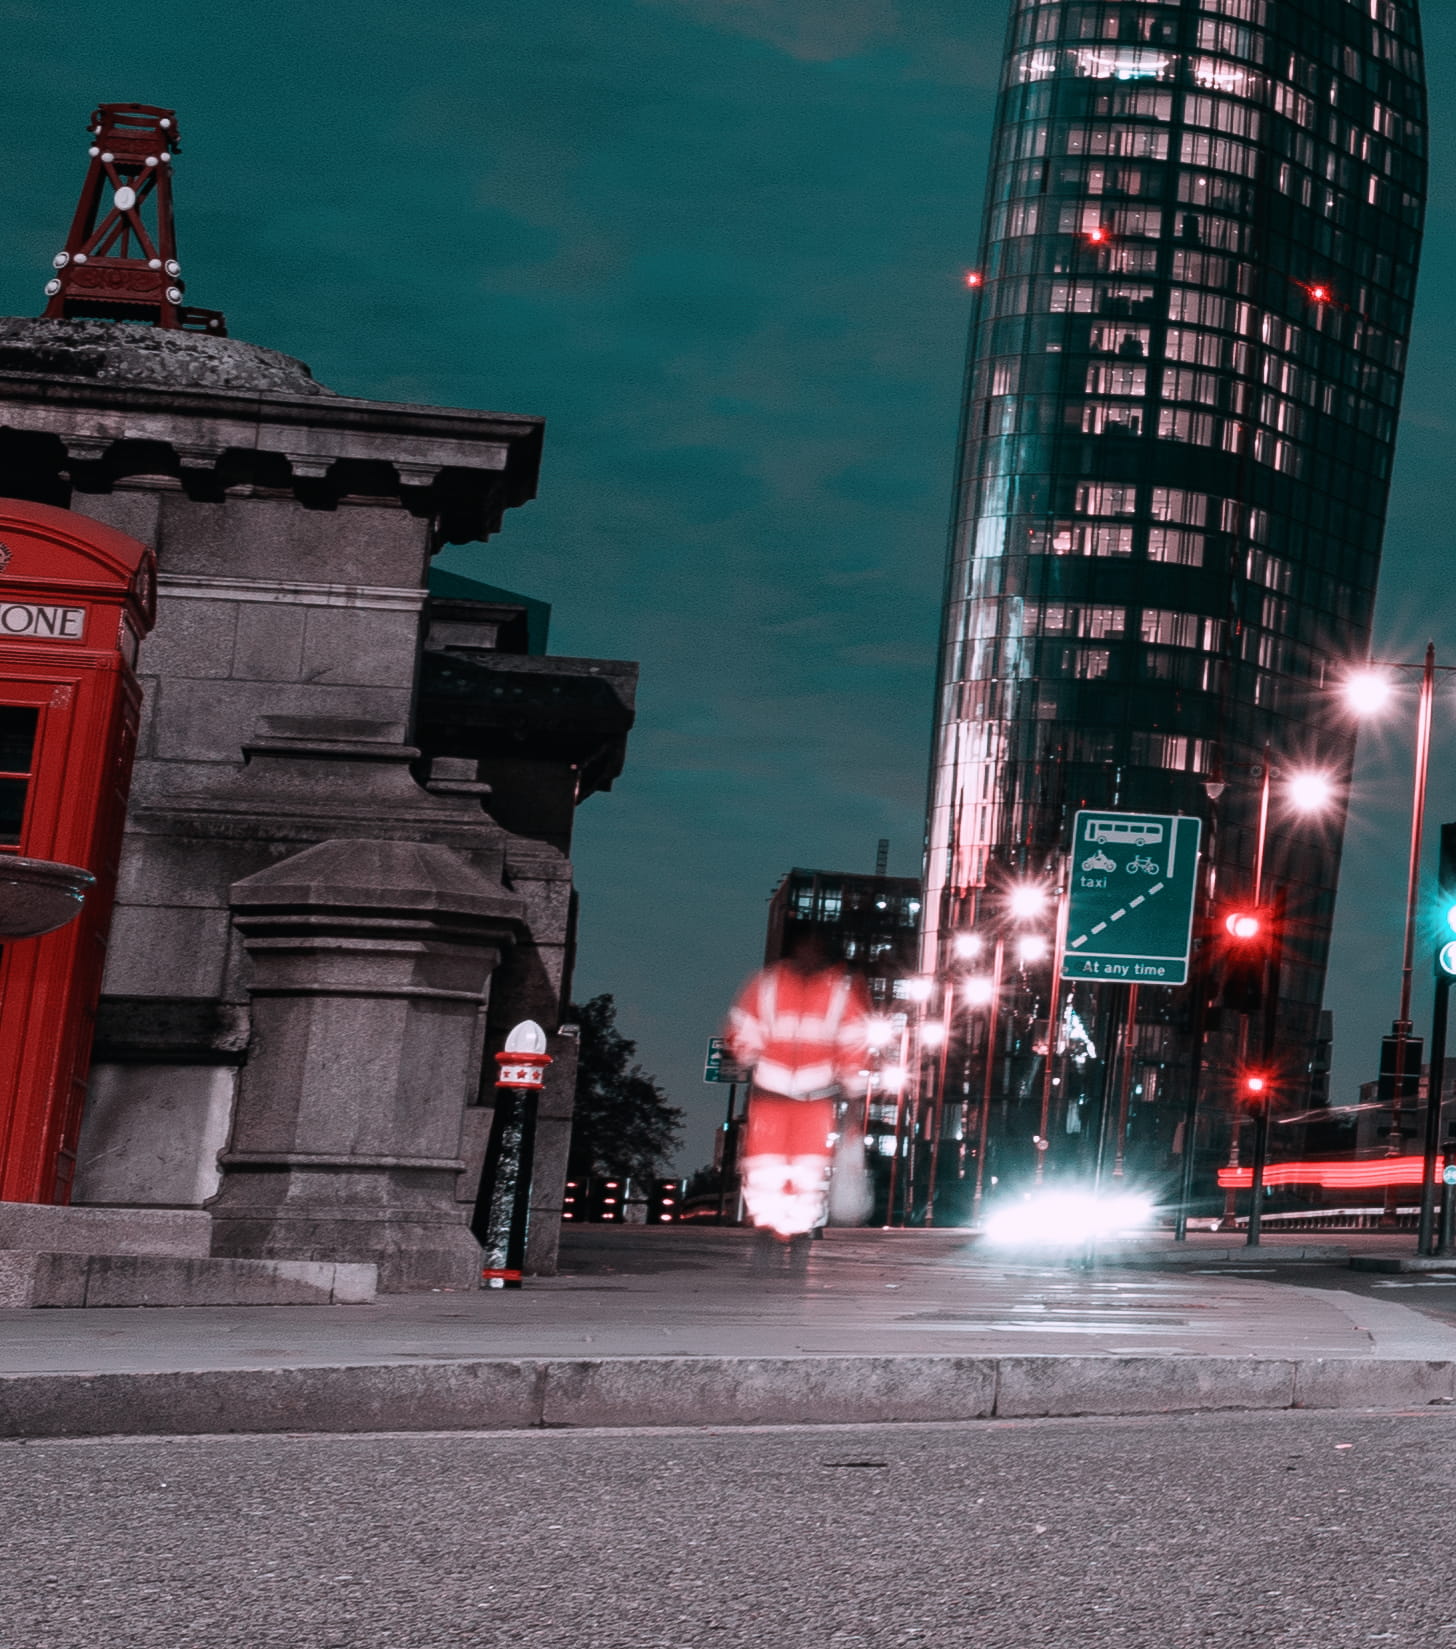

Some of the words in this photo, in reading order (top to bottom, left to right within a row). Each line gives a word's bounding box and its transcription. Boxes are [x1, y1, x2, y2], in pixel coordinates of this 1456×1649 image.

[0, 605, 82, 636] ONE
[1080, 876, 1107, 888] taxi
[1082, 960, 1099, 973] At
[1104, 964, 1129, 976] any
[1134, 963, 1166, 976] time
